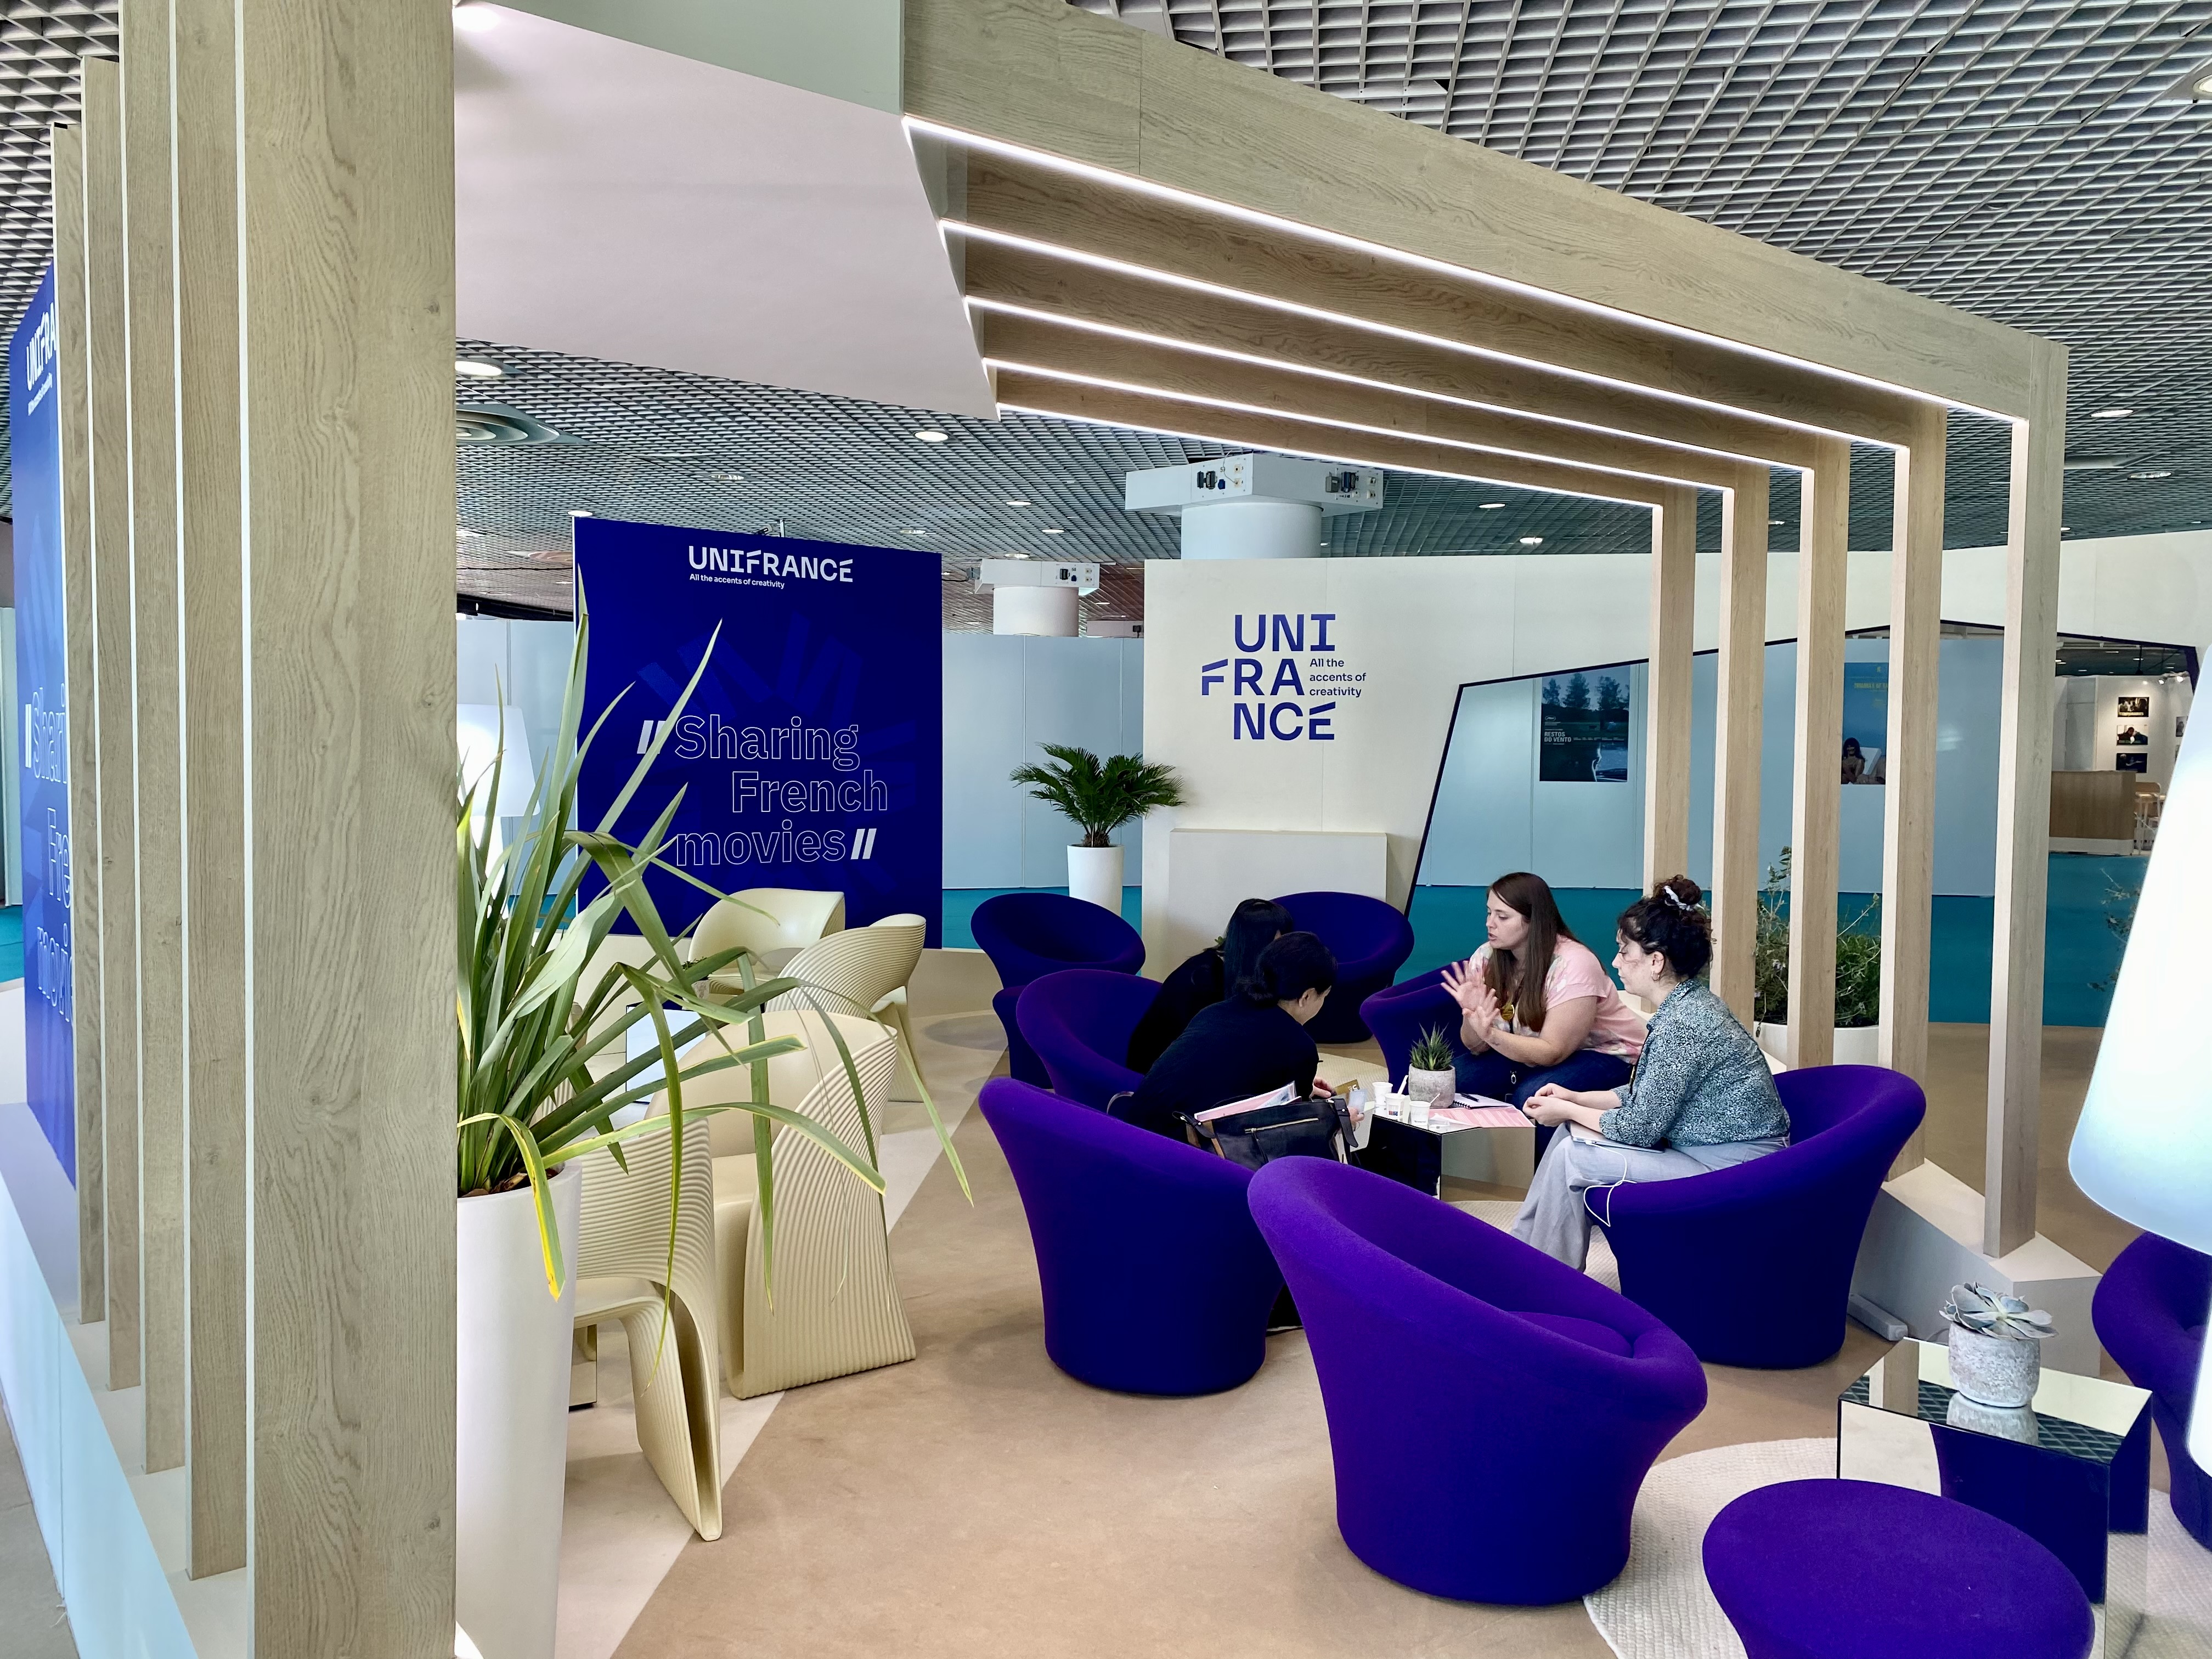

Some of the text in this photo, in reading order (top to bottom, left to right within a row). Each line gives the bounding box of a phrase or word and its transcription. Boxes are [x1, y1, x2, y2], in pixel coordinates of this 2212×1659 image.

[752, 580, 785, 589] creativity
[1234, 613, 1336, 652] UNI
[1310, 658, 1345, 667] All the
[1201, 658, 1305, 696] FRA
[1310, 672, 1367, 681] accents of
[1309, 686, 1362, 698] creativity
[732, 769, 888, 813] French
